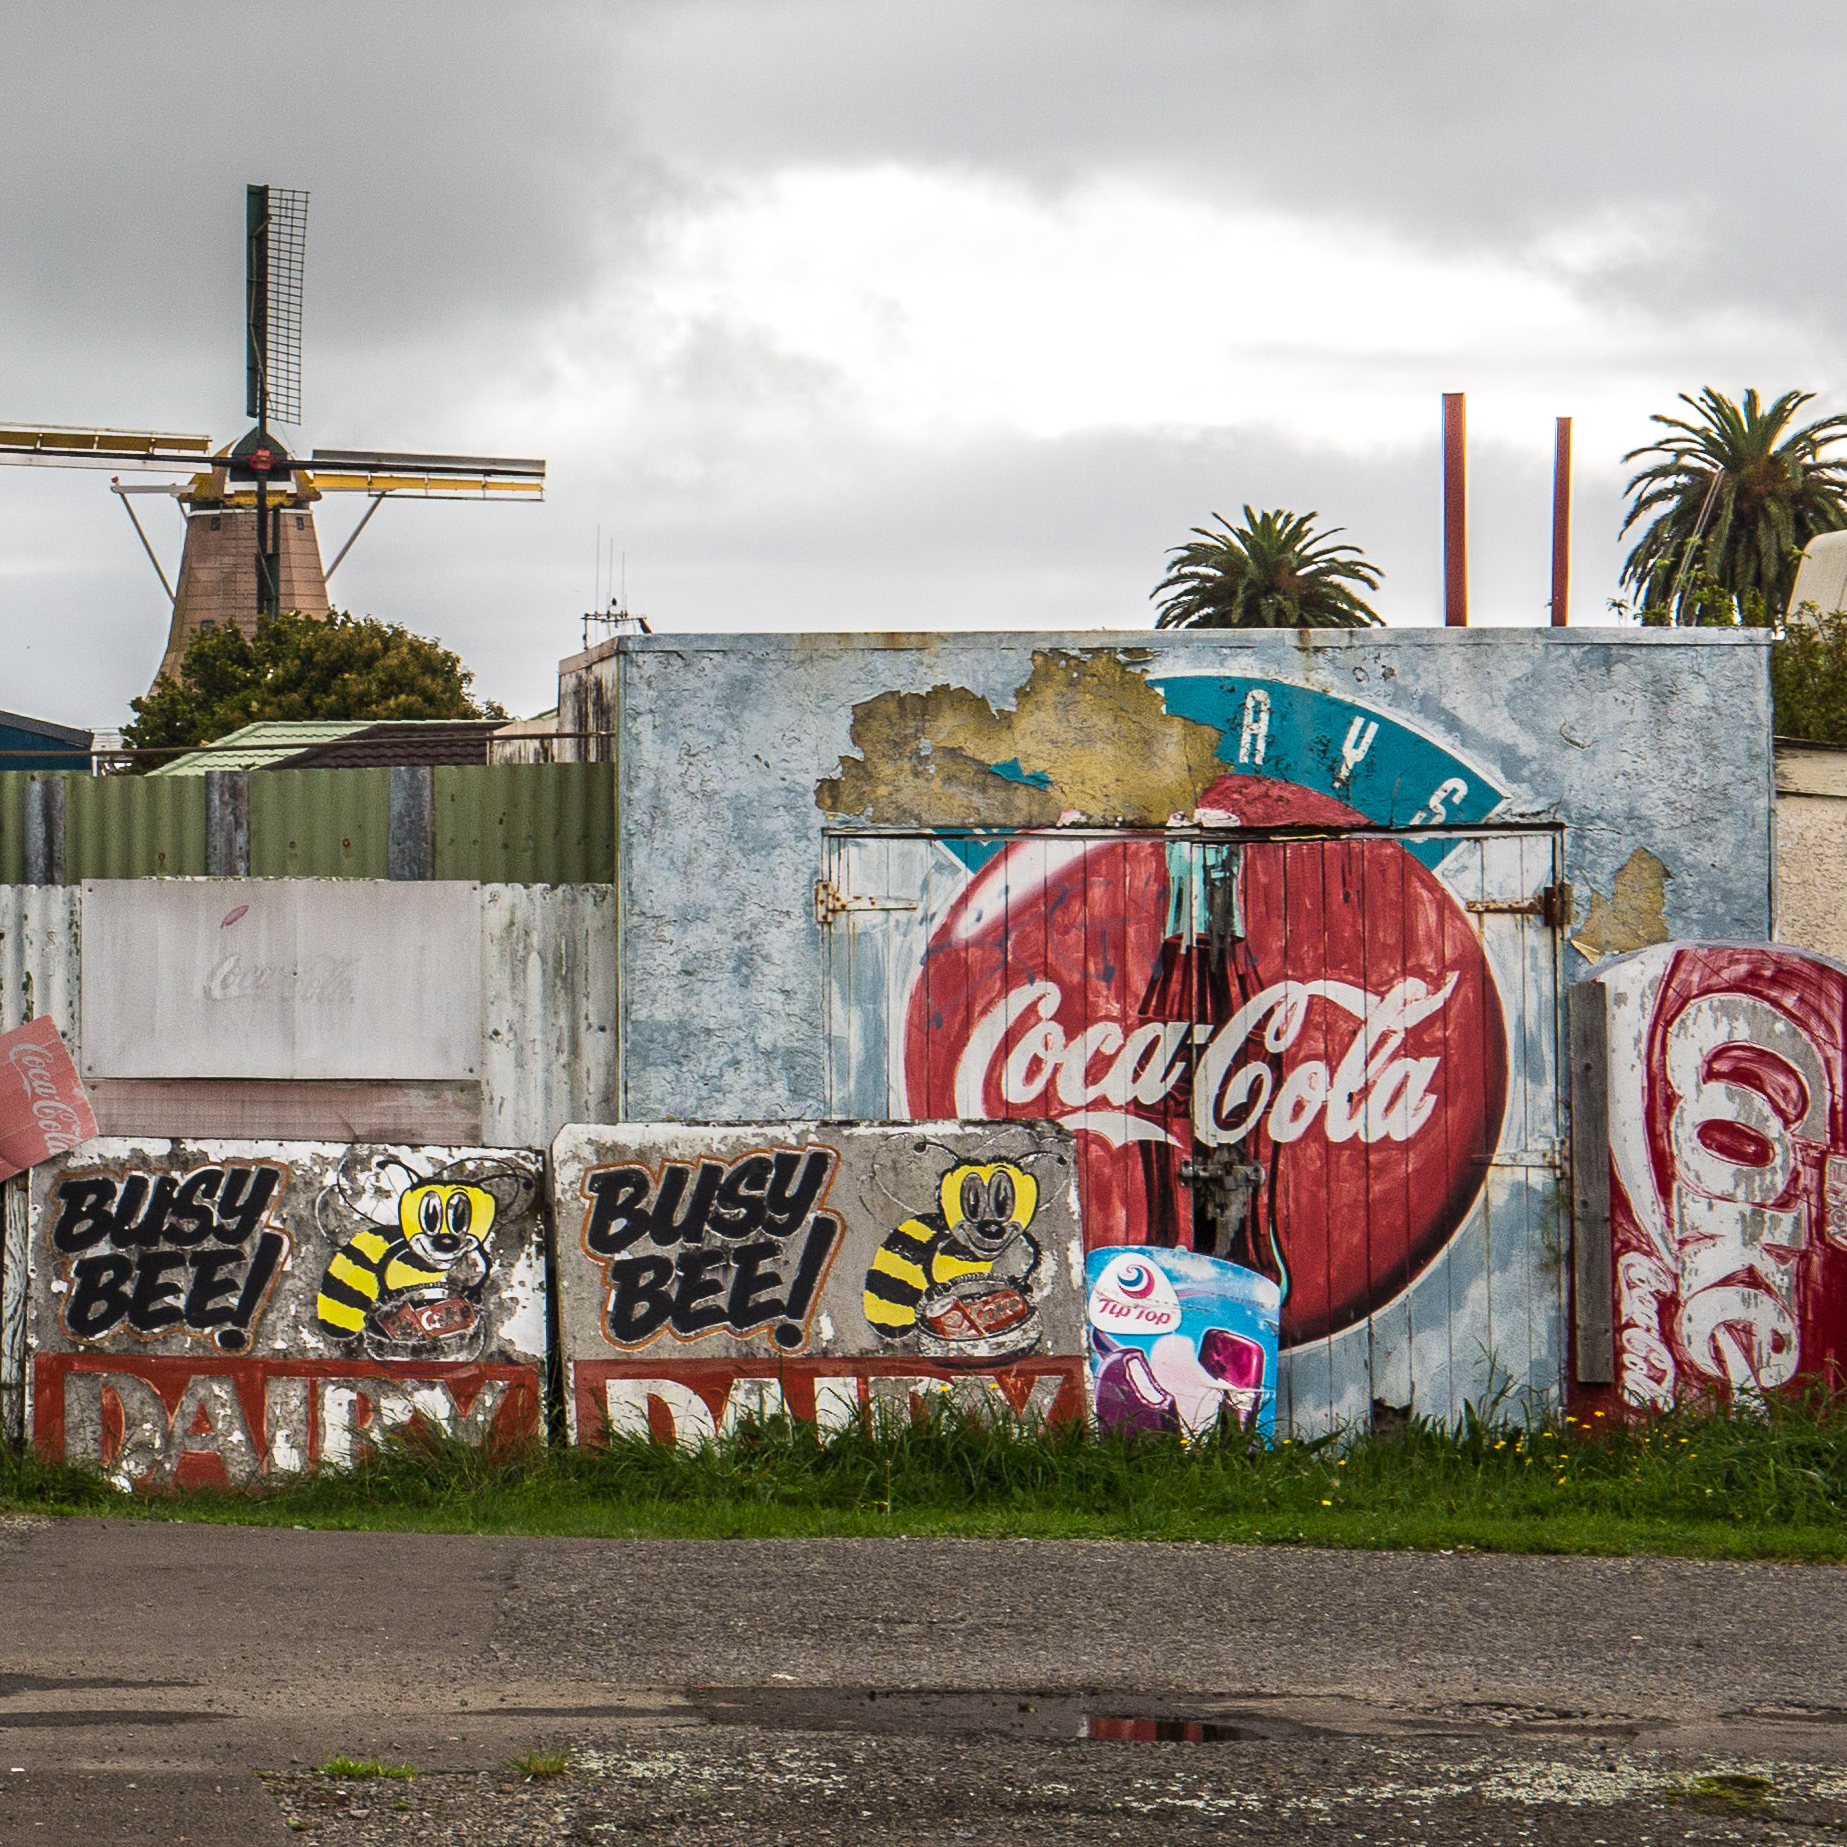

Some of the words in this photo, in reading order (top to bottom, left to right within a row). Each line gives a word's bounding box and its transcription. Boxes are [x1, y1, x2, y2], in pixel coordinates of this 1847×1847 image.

[955, 971, 1462, 1156] Coca-Cola
[51, 1164, 282, 1253] BUSY
[587, 1150, 832, 1254] BUSY
[1666, 991, 1833, 1403] Coke
[67, 1231, 288, 1353] BEE!
[609, 1214, 838, 1350] BEE!
[1098, 1298, 1131, 1318] Tip
[1134, 1305, 1172, 1326] Top
